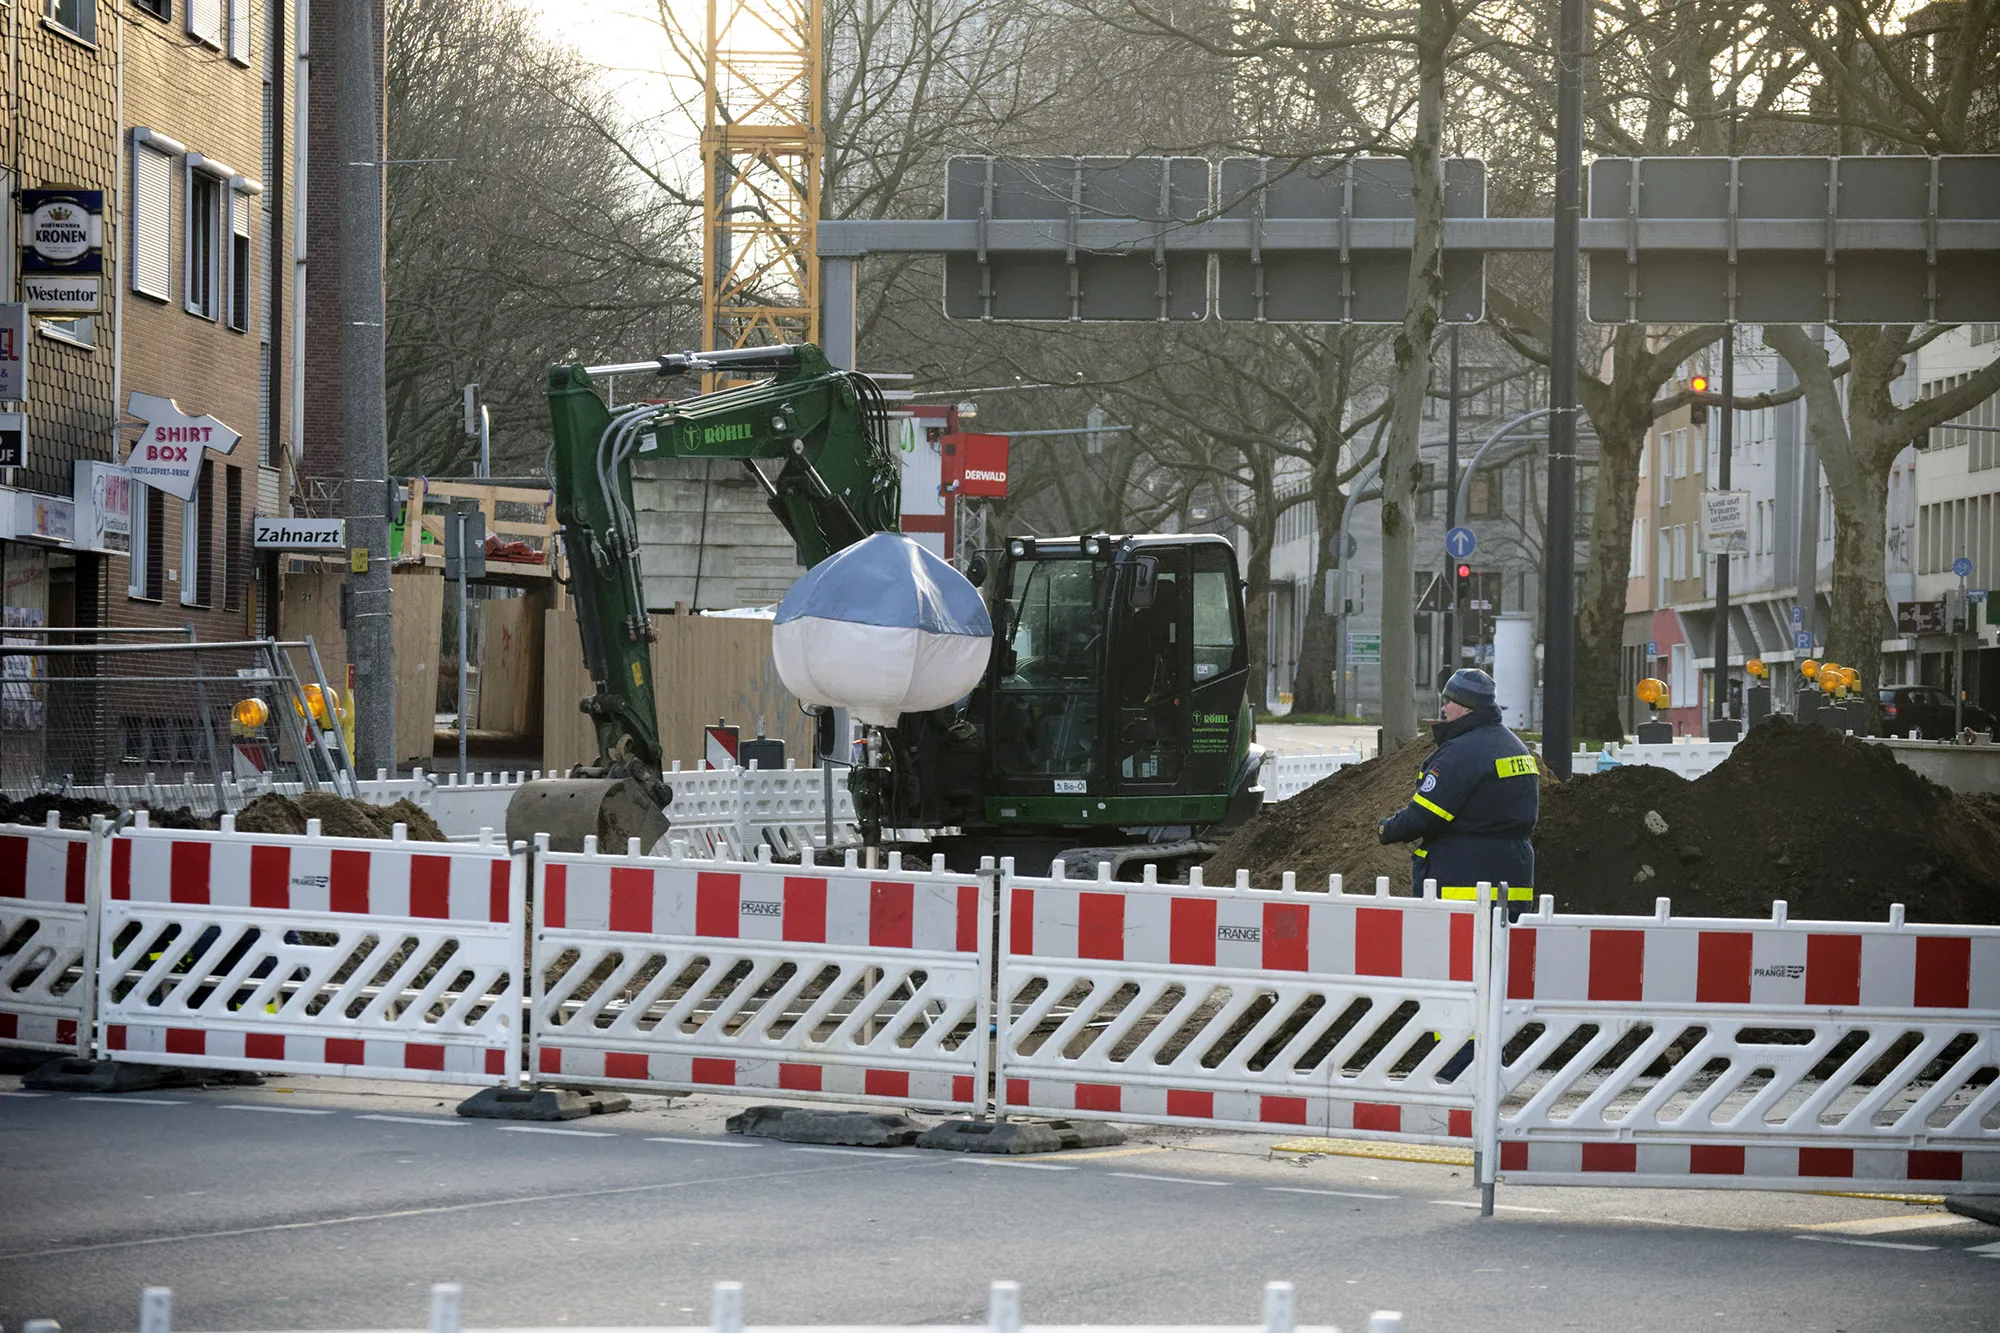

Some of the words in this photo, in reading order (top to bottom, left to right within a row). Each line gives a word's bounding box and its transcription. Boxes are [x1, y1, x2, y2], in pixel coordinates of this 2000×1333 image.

[36, 230, 86, 243] KRONEN
[26, 286, 97, 302] Westentor
[155, 427, 213, 442] SHIRT
[704, 423, 753, 444] RÖHLL
[146, 445, 188, 462] BOX
[965, 470, 1006, 482] DERWALD
[1707, 500, 1725, 508] Lust
[257, 527, 340, 543] Zahnarzt
[741, 902, 781, 914] PRANGE
[1217, 927, 1260, 940] PRANGE
[1754, 968, 1786, 977] PRANGE
